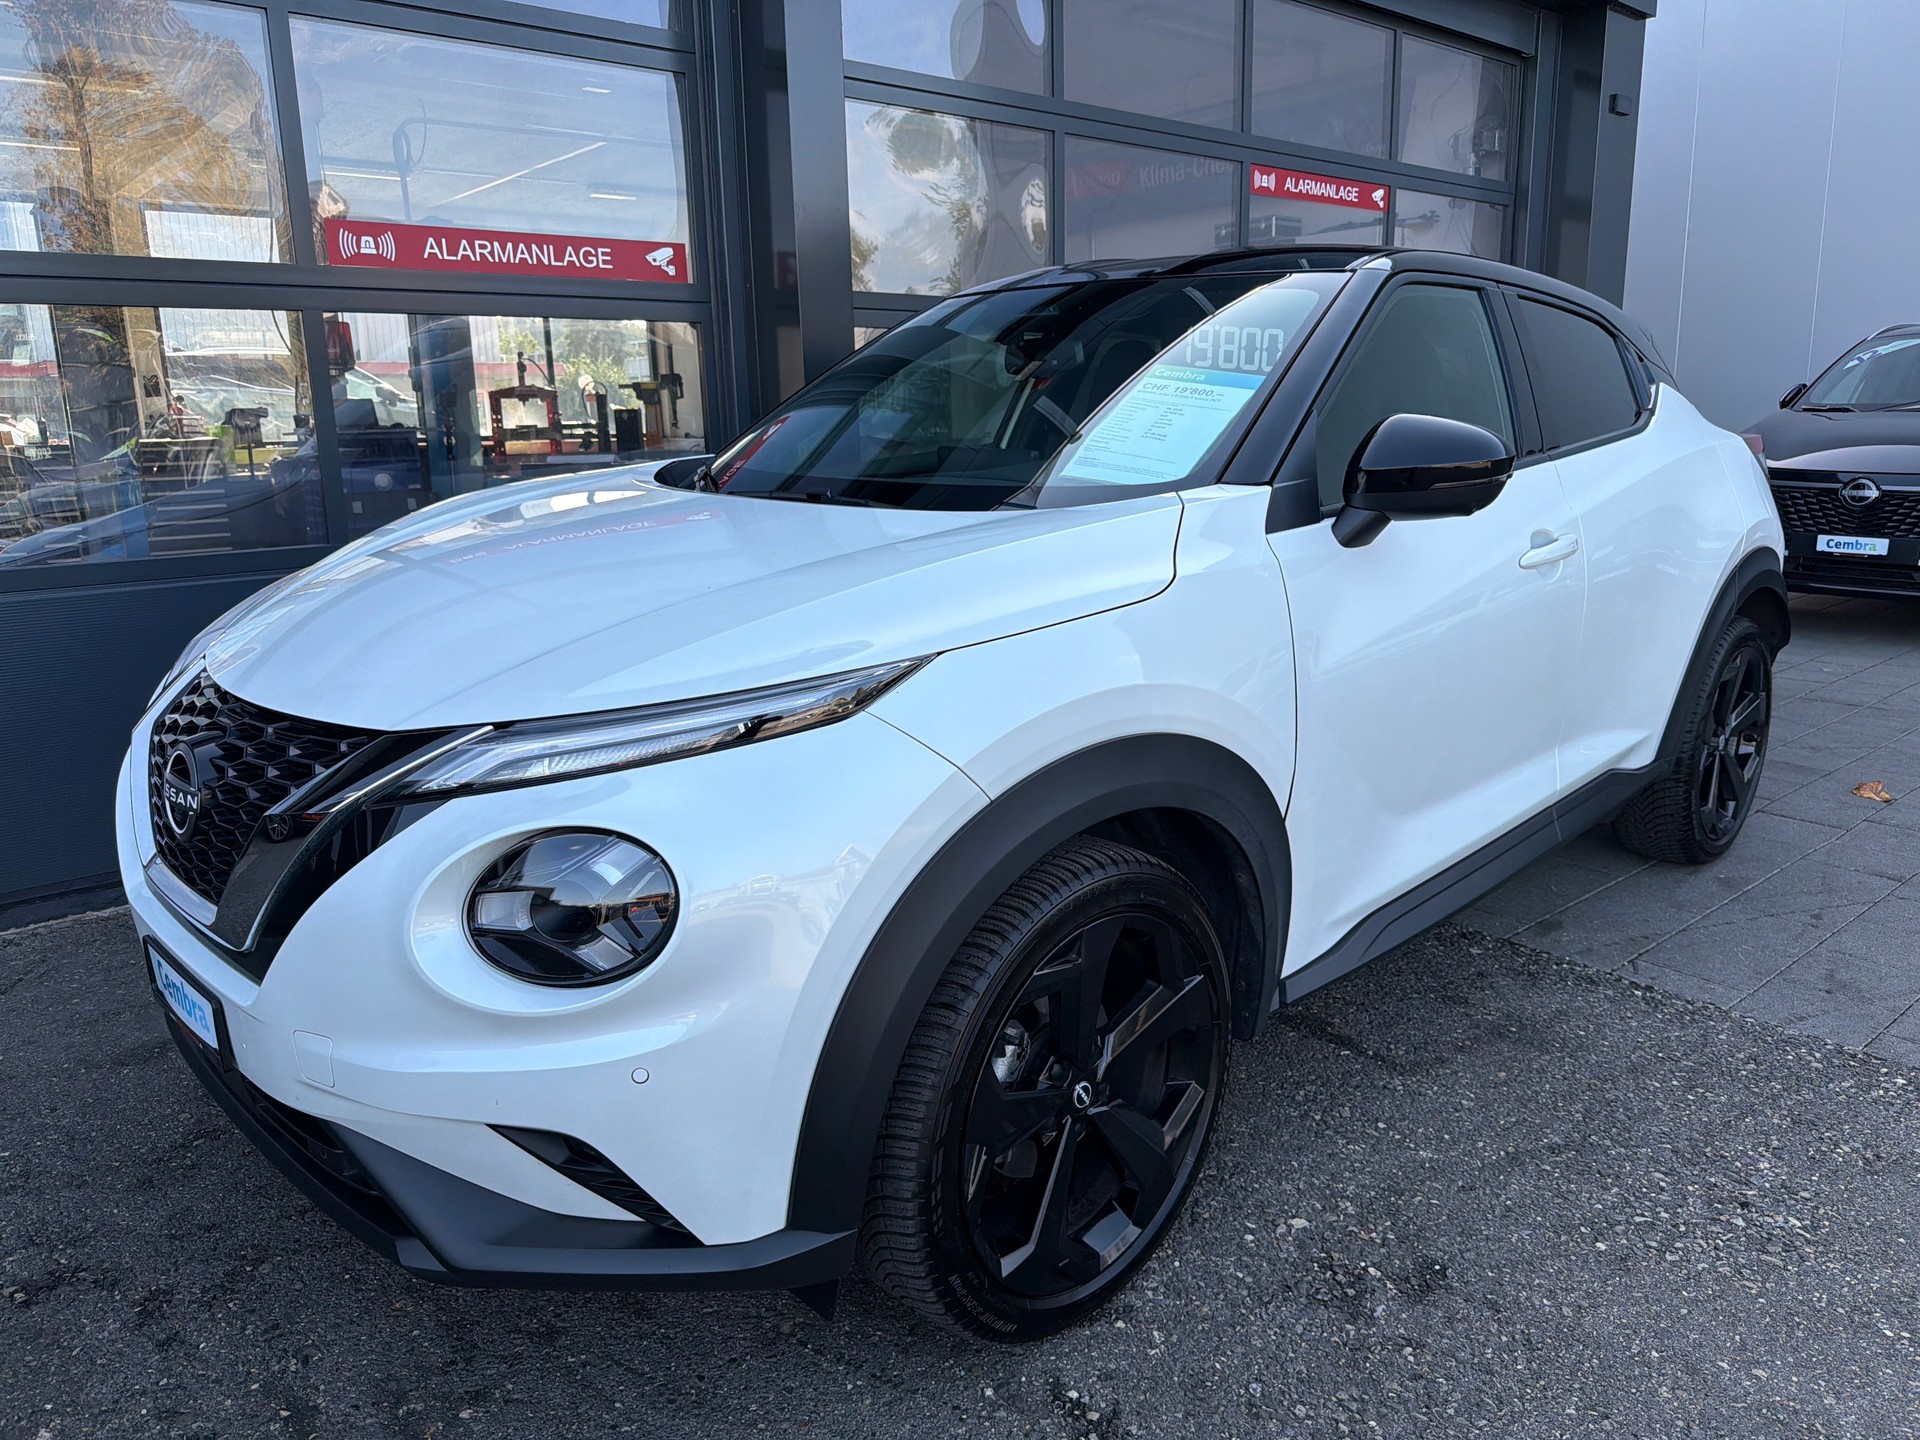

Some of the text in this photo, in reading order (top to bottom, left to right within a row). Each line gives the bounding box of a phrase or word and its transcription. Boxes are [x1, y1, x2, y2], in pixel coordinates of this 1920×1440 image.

[1284, 177, 1359, 202] ALARMANLAGE
[423, 237, 614, 269] ALARMANLAGE
[1142, 382, 1171, 391] CHF
[1154, 368, 1207, 381] Cembra
[1826, 538, 1877, 552] Cembra
[165, 783, 198, 809] SSAN
[157, 959, 210, 1034] Cembra
